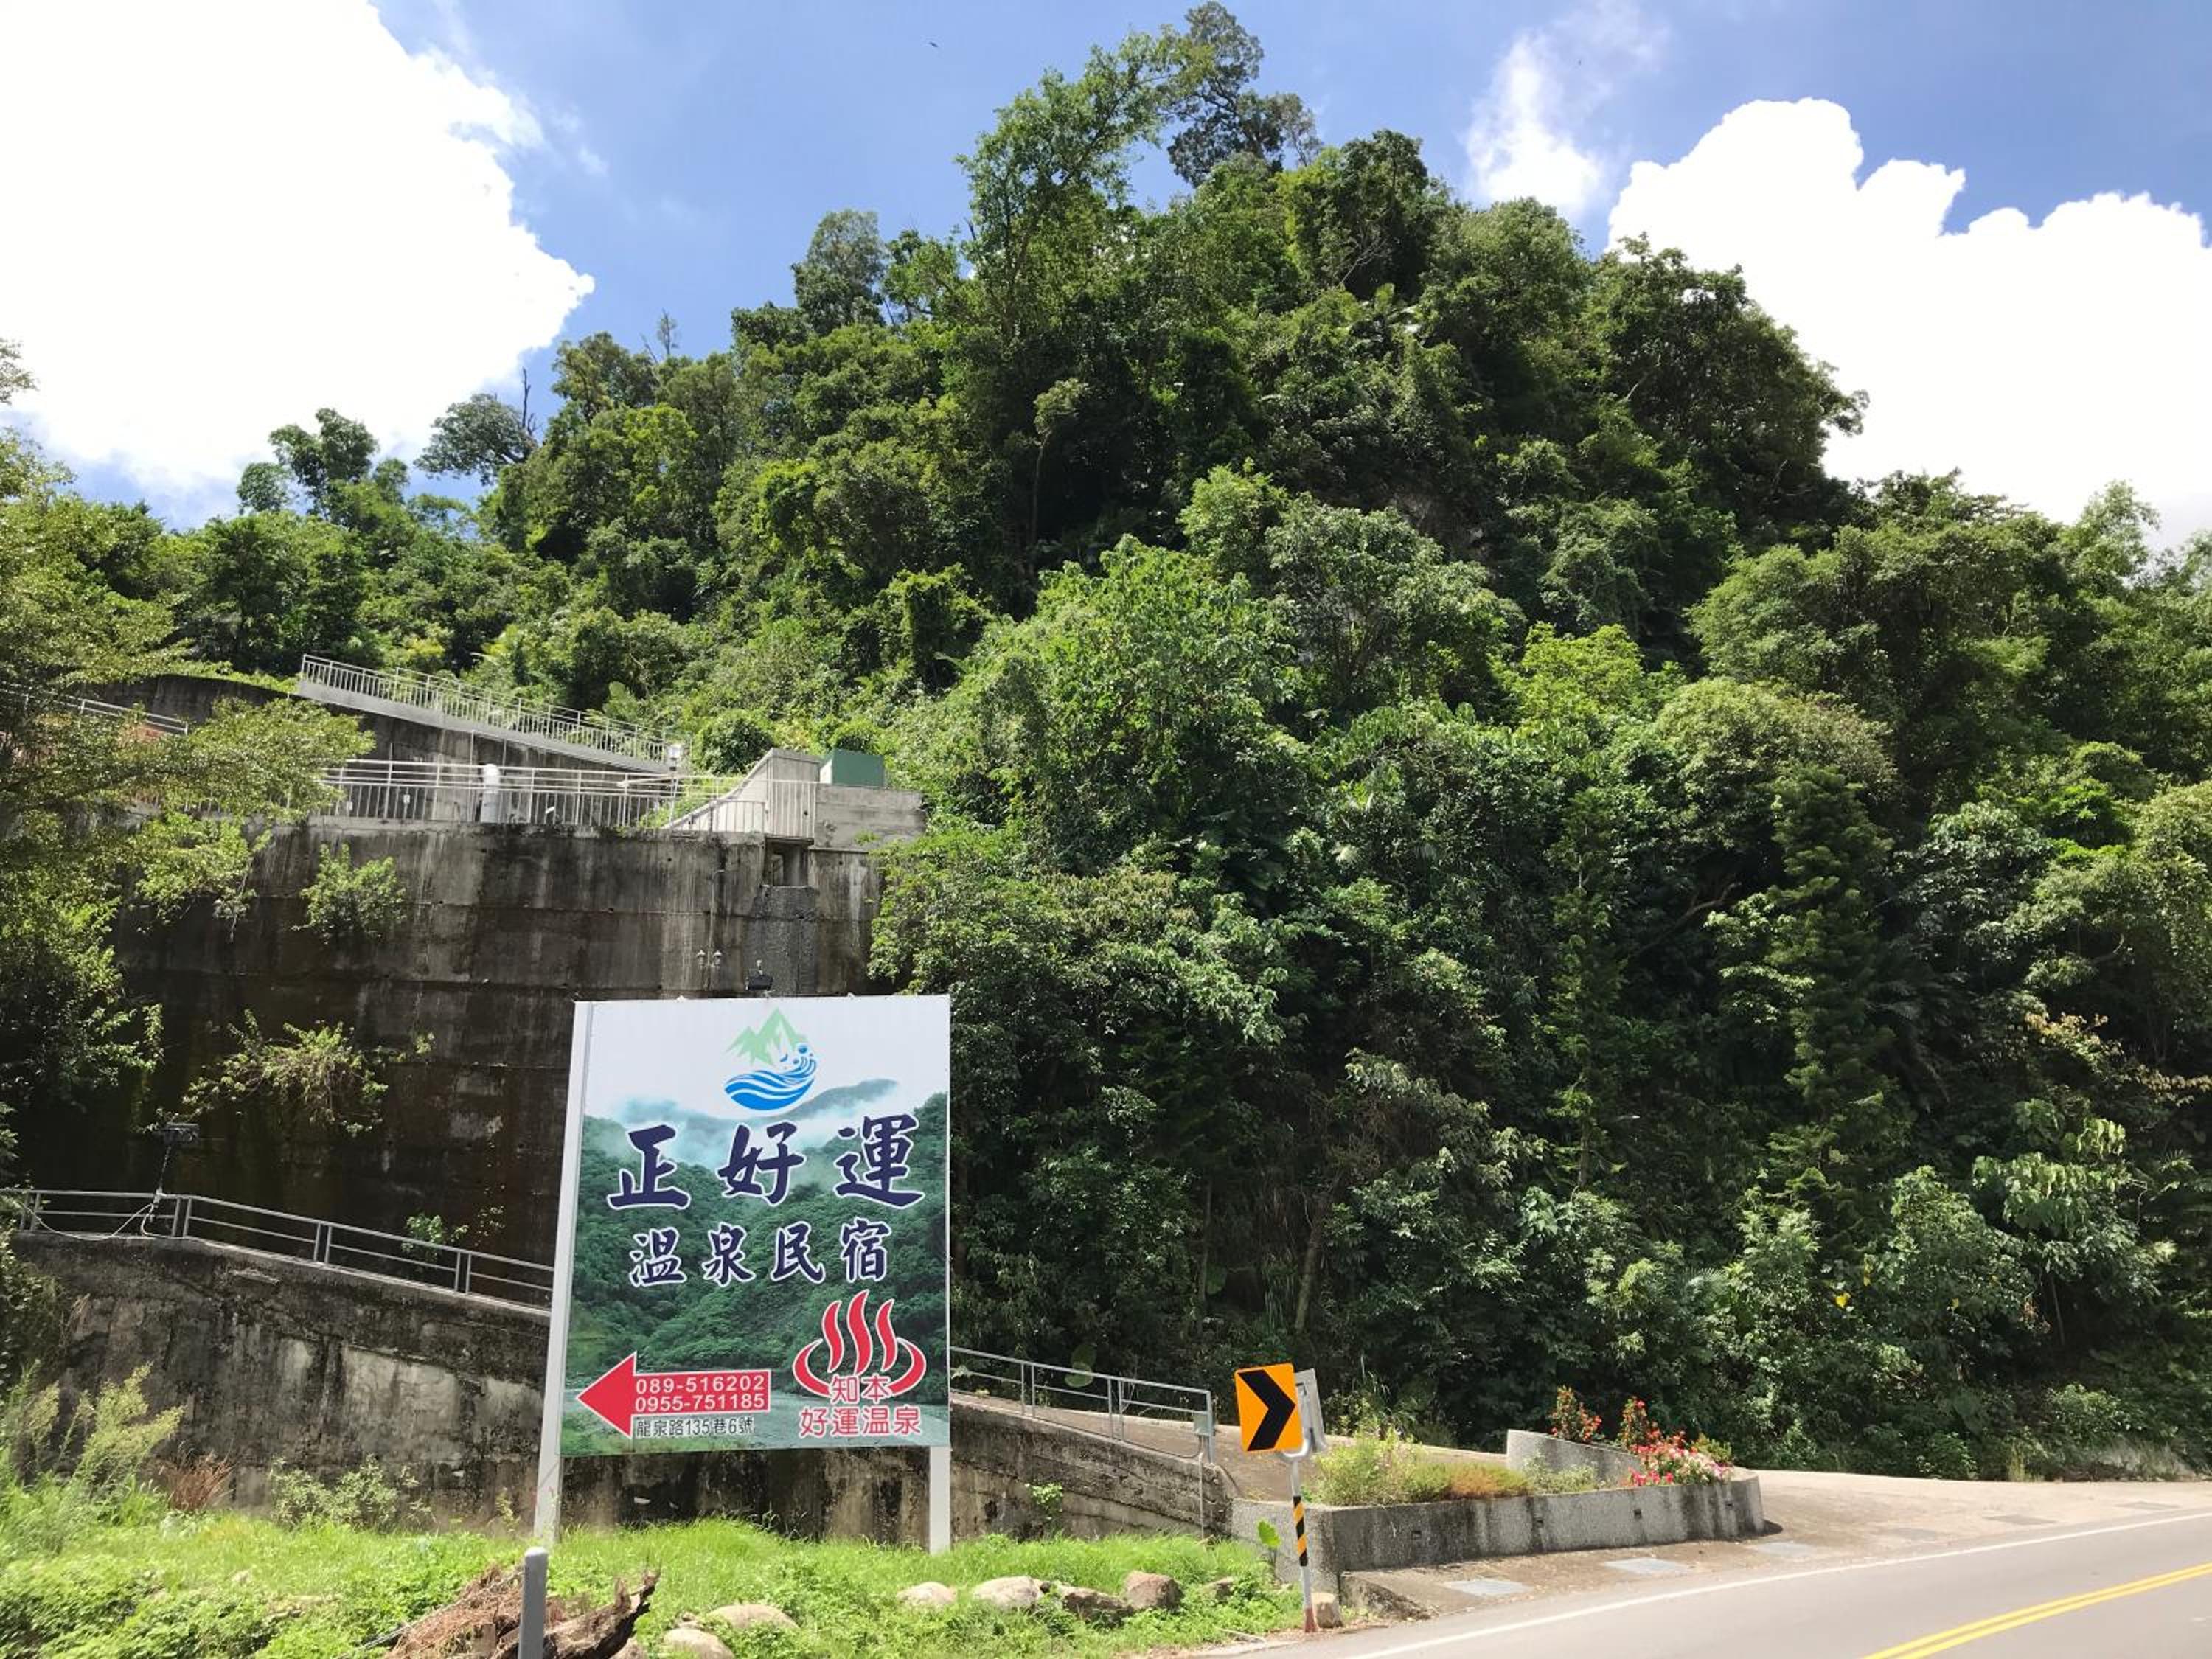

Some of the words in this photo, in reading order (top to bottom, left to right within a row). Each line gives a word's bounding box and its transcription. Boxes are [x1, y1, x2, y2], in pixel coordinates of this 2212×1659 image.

[608, 1115, 924, 1208] 正好運
[636, 1375, 765, 1394] 089-516202
[831, 1374, 891, 1405] 知本
[636, 1394, 765, 1413] 0955-751185
